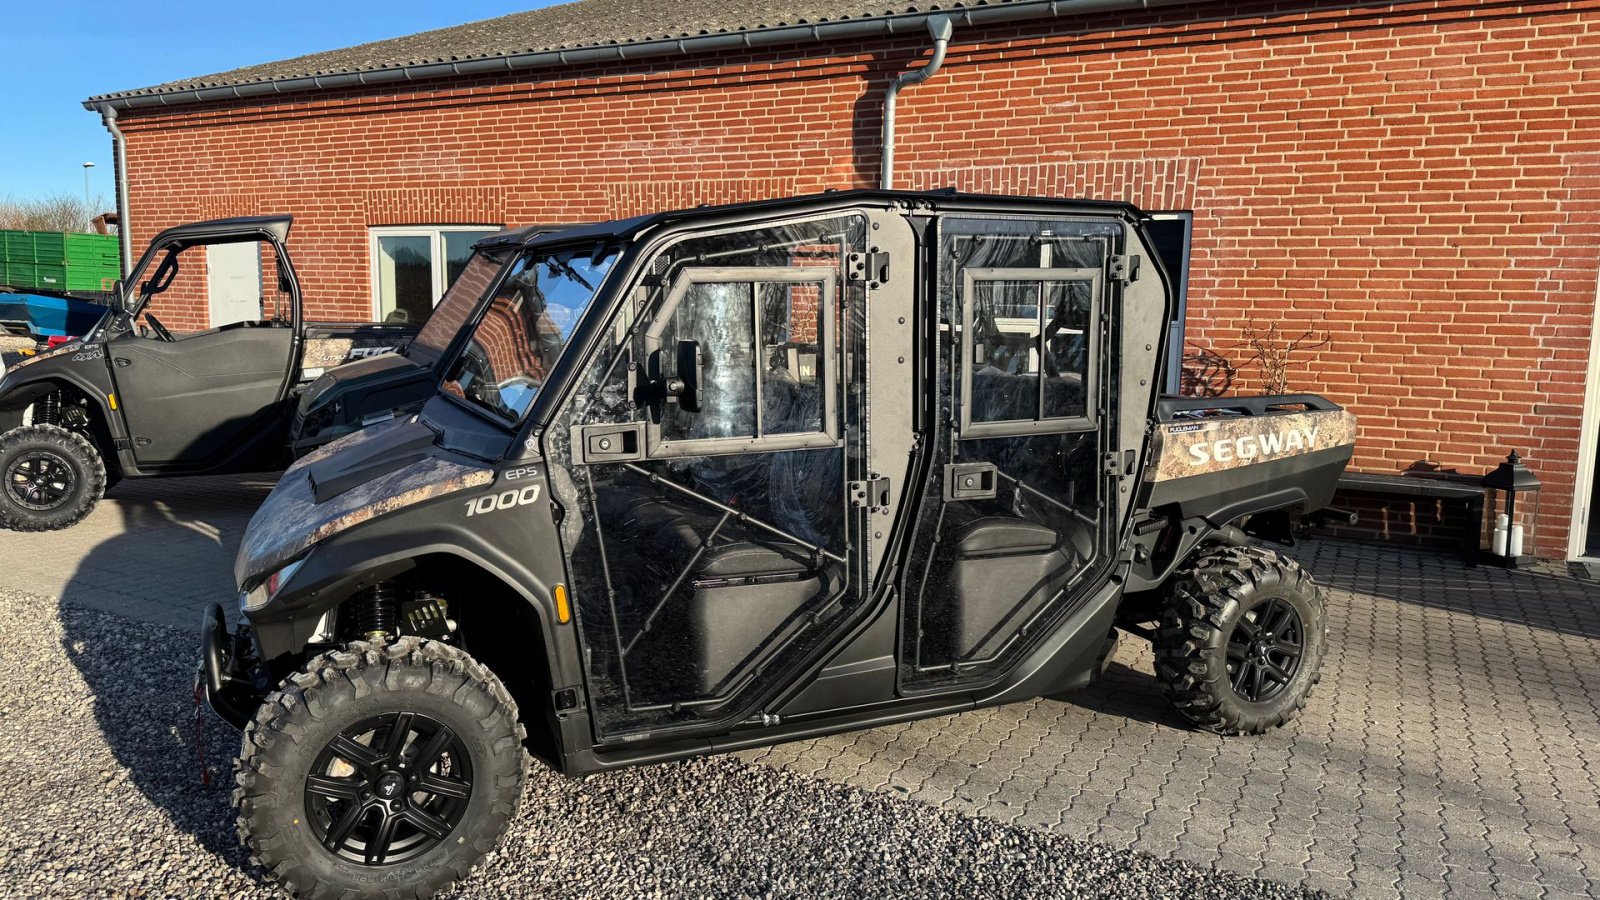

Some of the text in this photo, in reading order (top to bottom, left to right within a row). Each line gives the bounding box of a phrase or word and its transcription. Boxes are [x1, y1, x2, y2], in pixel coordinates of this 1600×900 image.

[1188, 426, 1319, 467] SEGWAY
[505, 466, 538, 480] EPS
[464, 484, 541, 517] 1000
